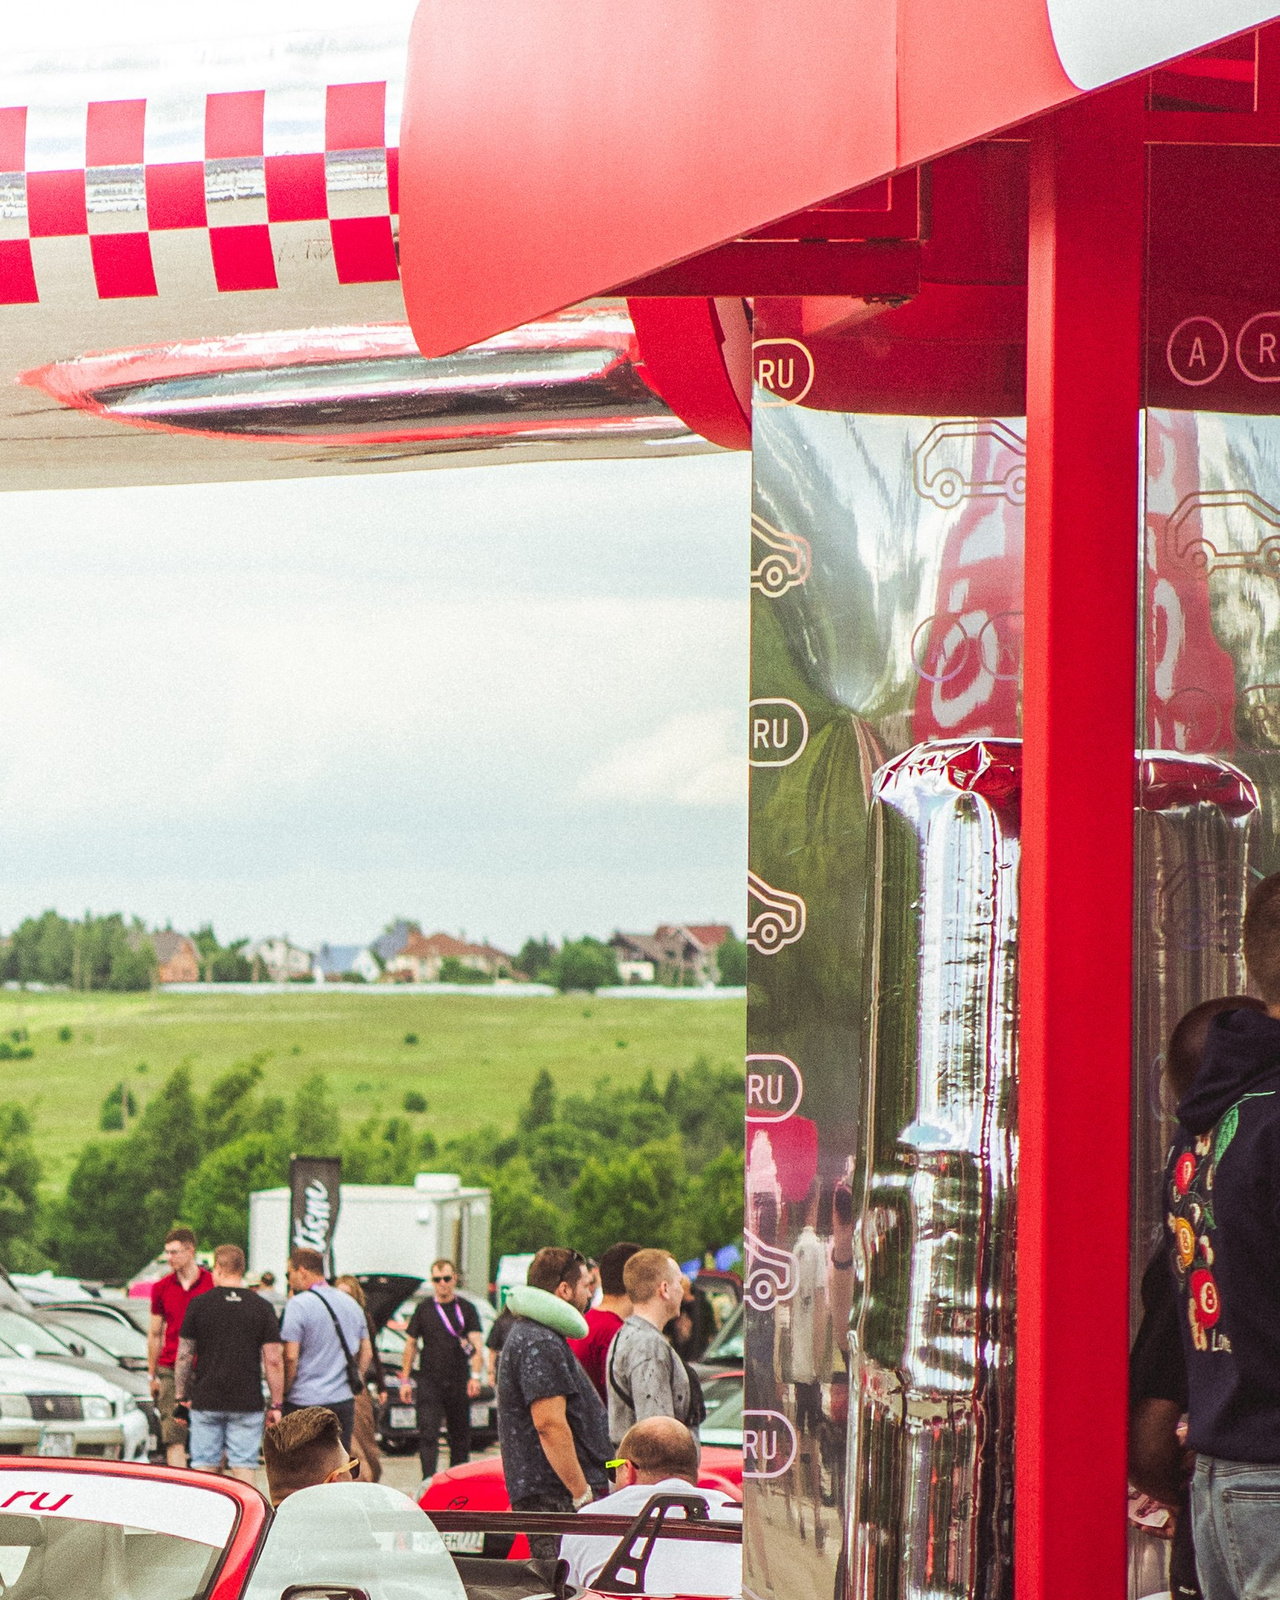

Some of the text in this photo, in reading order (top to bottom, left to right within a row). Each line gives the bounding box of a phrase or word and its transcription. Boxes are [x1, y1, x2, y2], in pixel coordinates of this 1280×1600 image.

[1188, 336, 1207, 368] A
[758, 358, 794, 389] RU
[753, 718, 789, 749] RU
[748, 1074, 783, 1105] RU
[743, 1430, 777, 1460] RU
